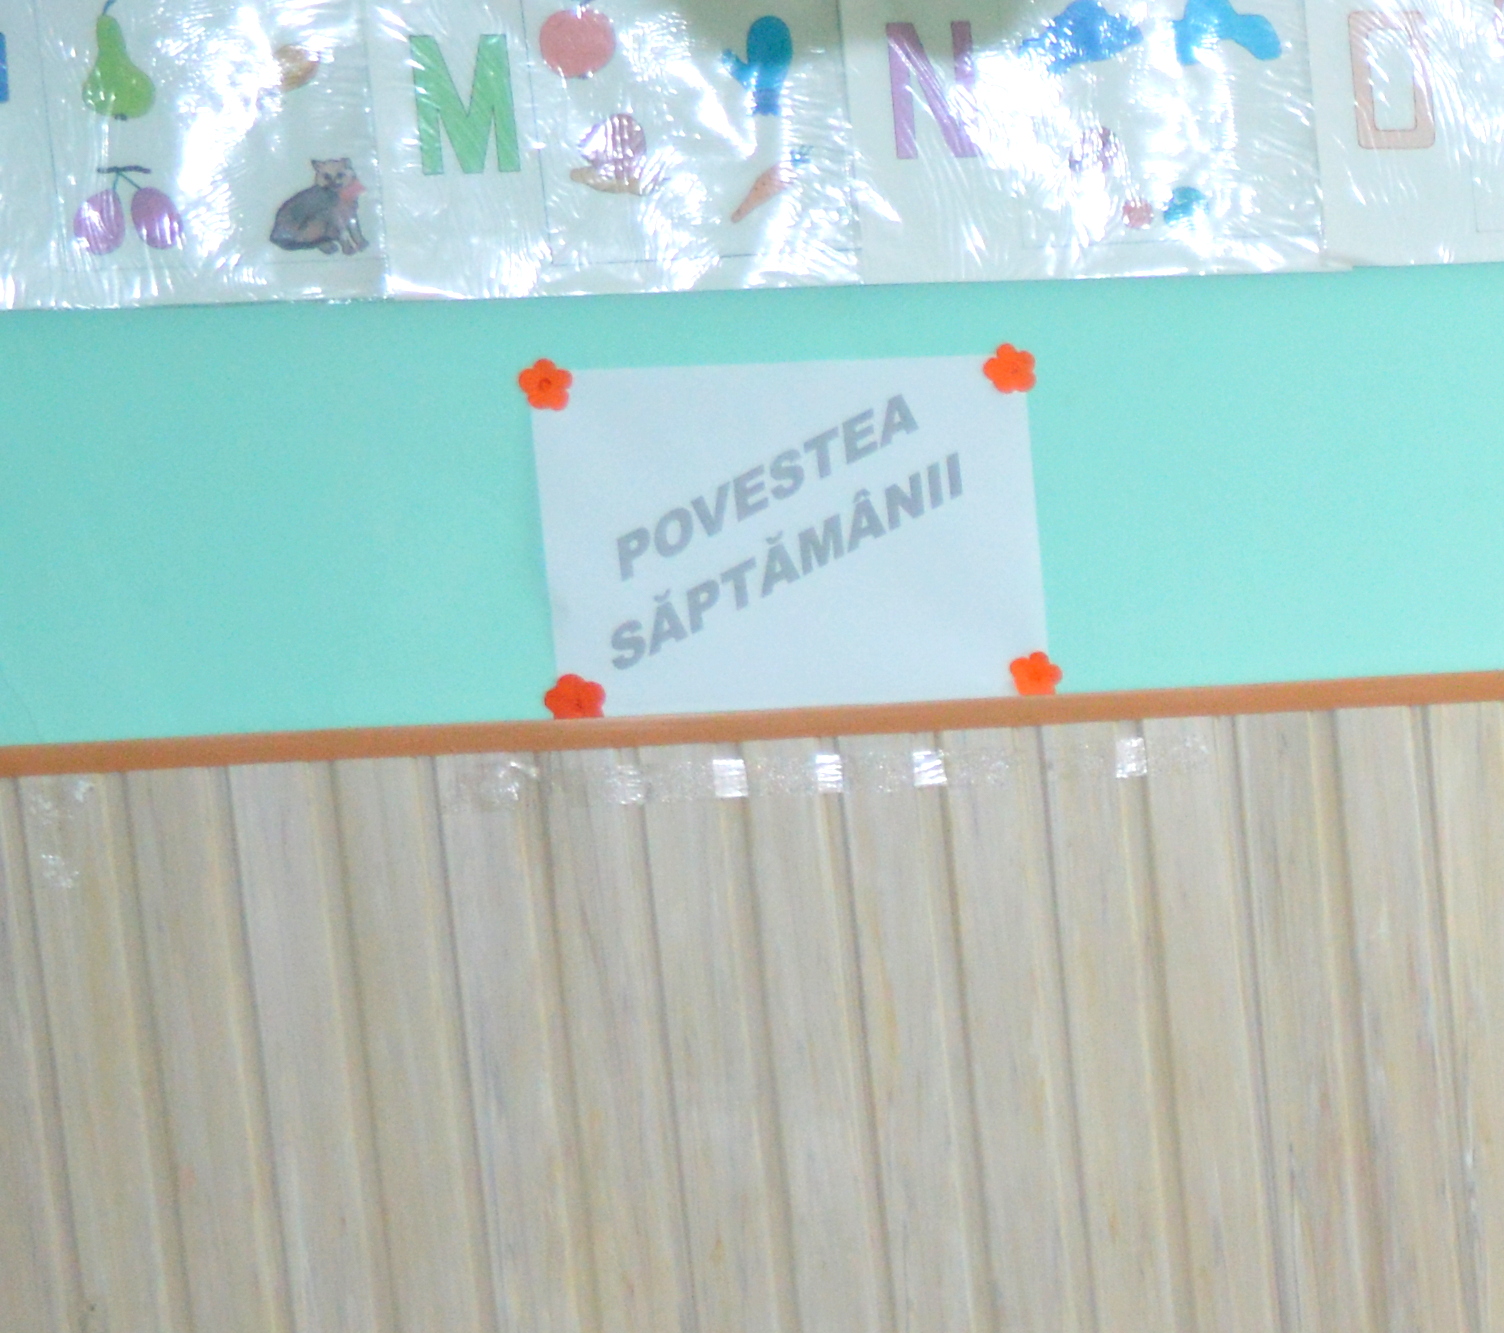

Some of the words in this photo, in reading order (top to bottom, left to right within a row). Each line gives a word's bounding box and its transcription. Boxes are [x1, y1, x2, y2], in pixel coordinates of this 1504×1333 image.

[408, 33, 522, 176] M
[885, 20, 982, 160] N
[610, 451, 964, 671] SĂPTĂMÂNII
[616, 393, 920, 582] POVESTEA
